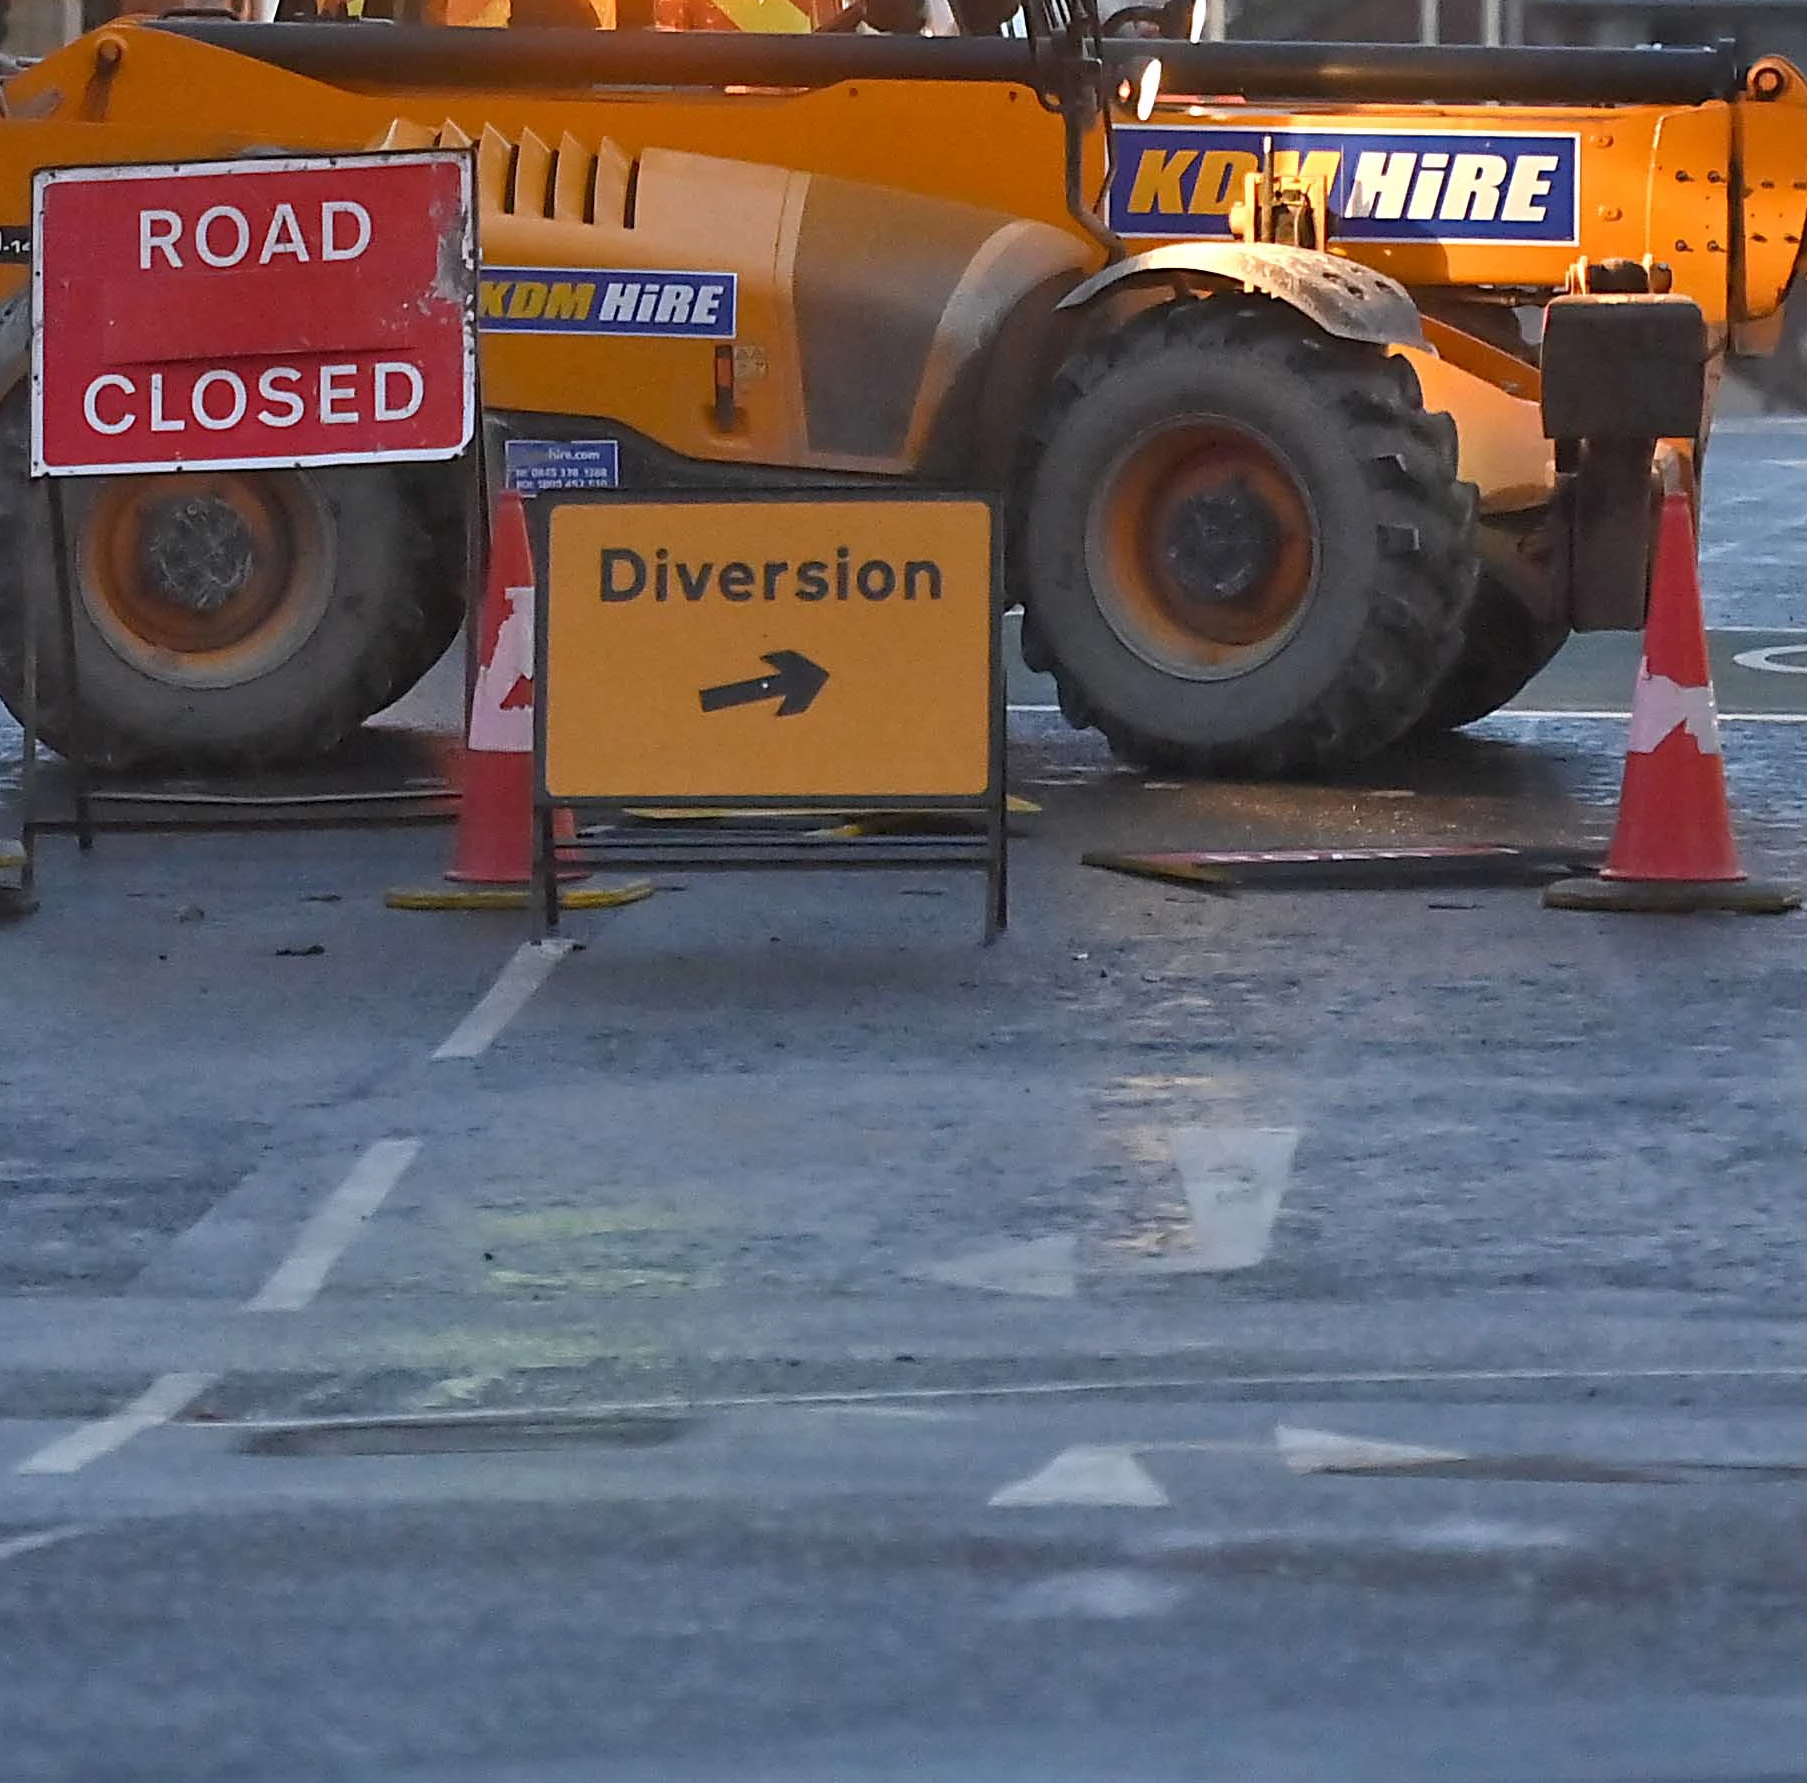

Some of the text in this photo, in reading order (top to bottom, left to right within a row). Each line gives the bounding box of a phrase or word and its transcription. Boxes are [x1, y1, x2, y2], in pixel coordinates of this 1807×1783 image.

[139, 200, 372, 270] ROAD
[478, 280, 596, 321] KDM
[84, 361, 425, 435] CLOSED
[600, 546, 942, 603] Diversion
